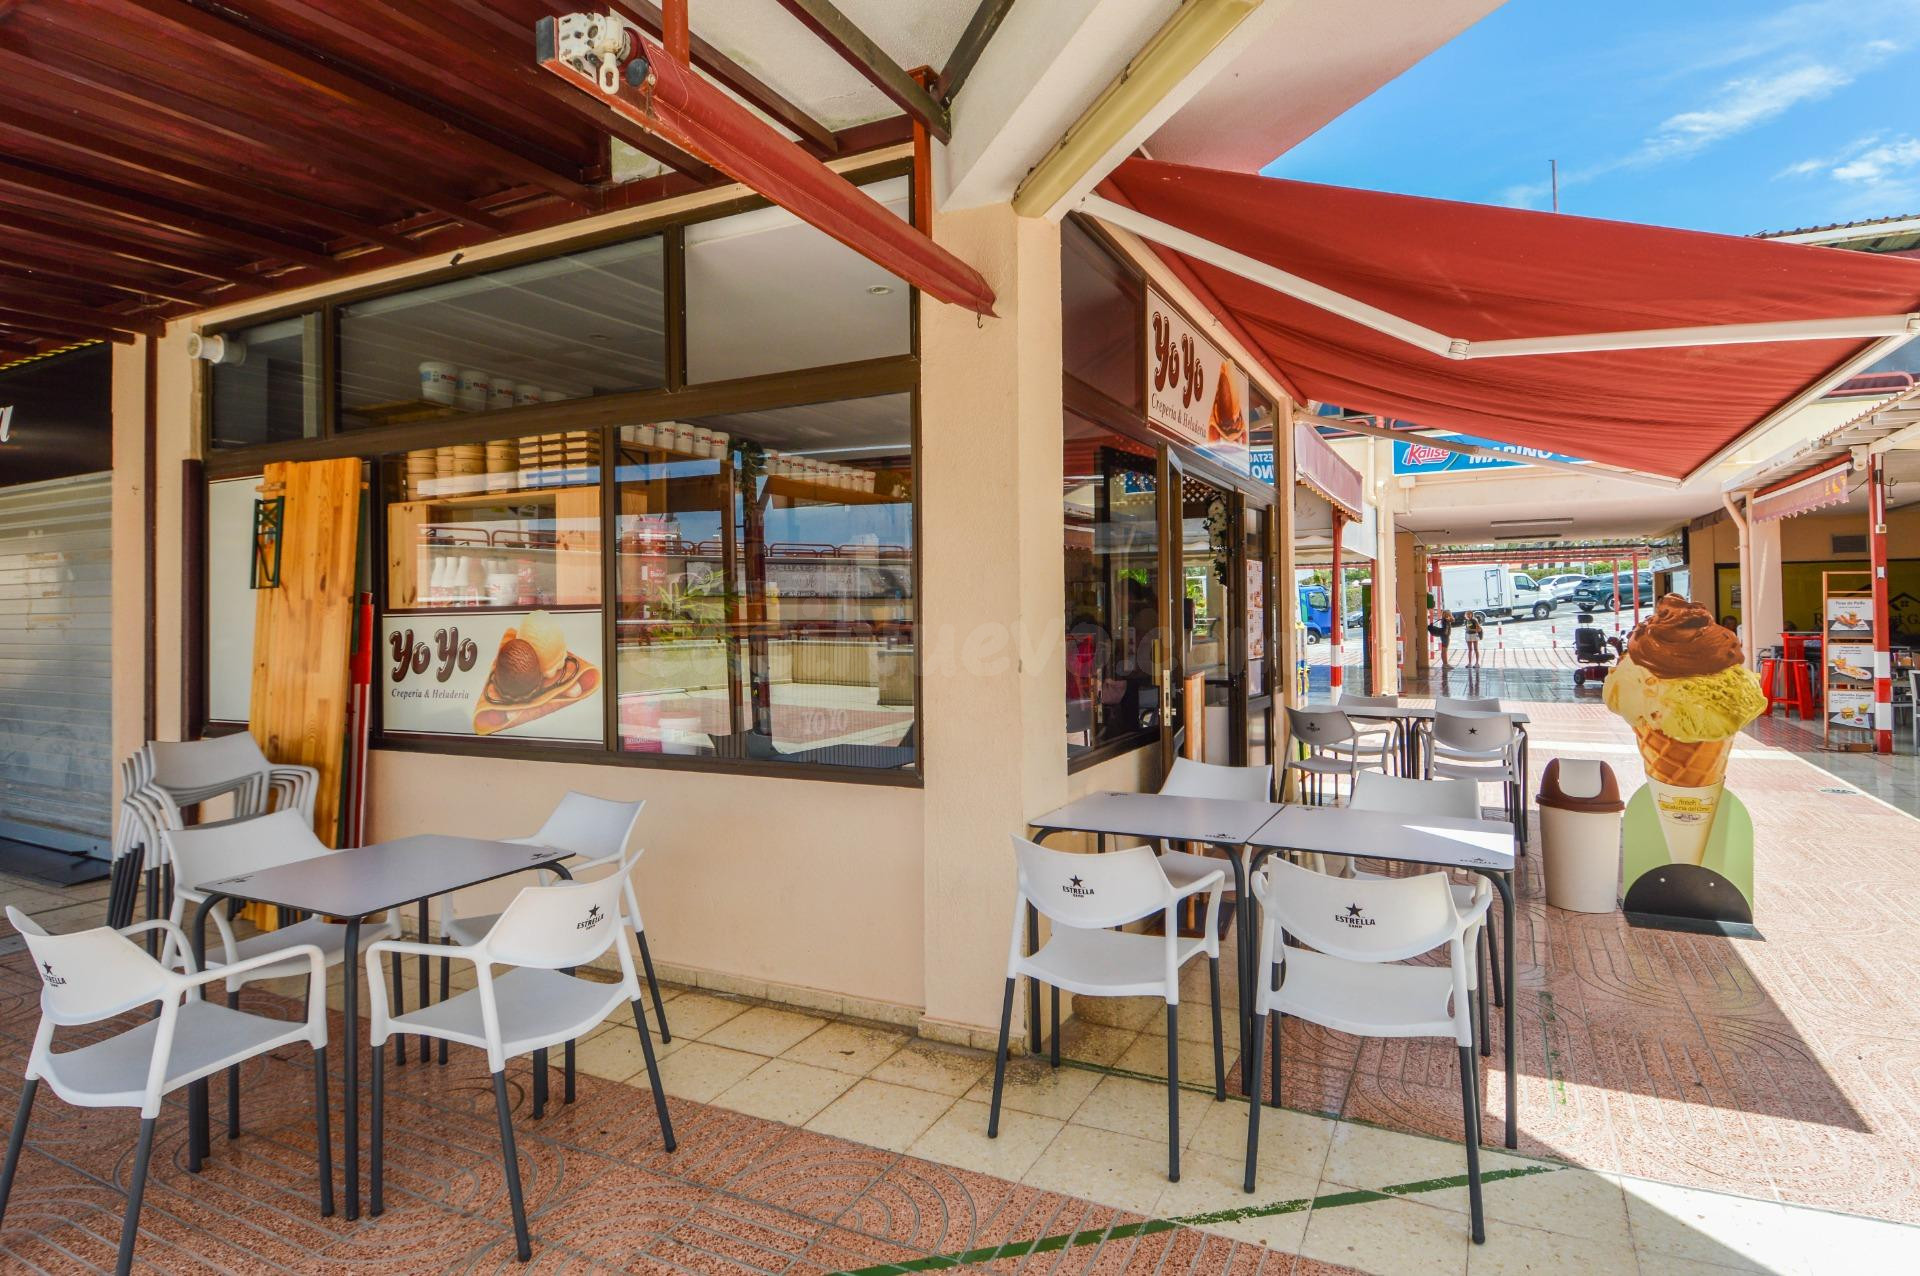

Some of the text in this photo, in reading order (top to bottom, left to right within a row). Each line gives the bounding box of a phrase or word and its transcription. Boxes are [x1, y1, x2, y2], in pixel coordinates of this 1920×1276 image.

[1405, 444, 1450, 465] Kalise
[1062, 885, 1095, 895] ESTRELLA
[576, 913, 605, 930] ESTRELLA
[1335, 914, 1376, 926] ESTRELLA
